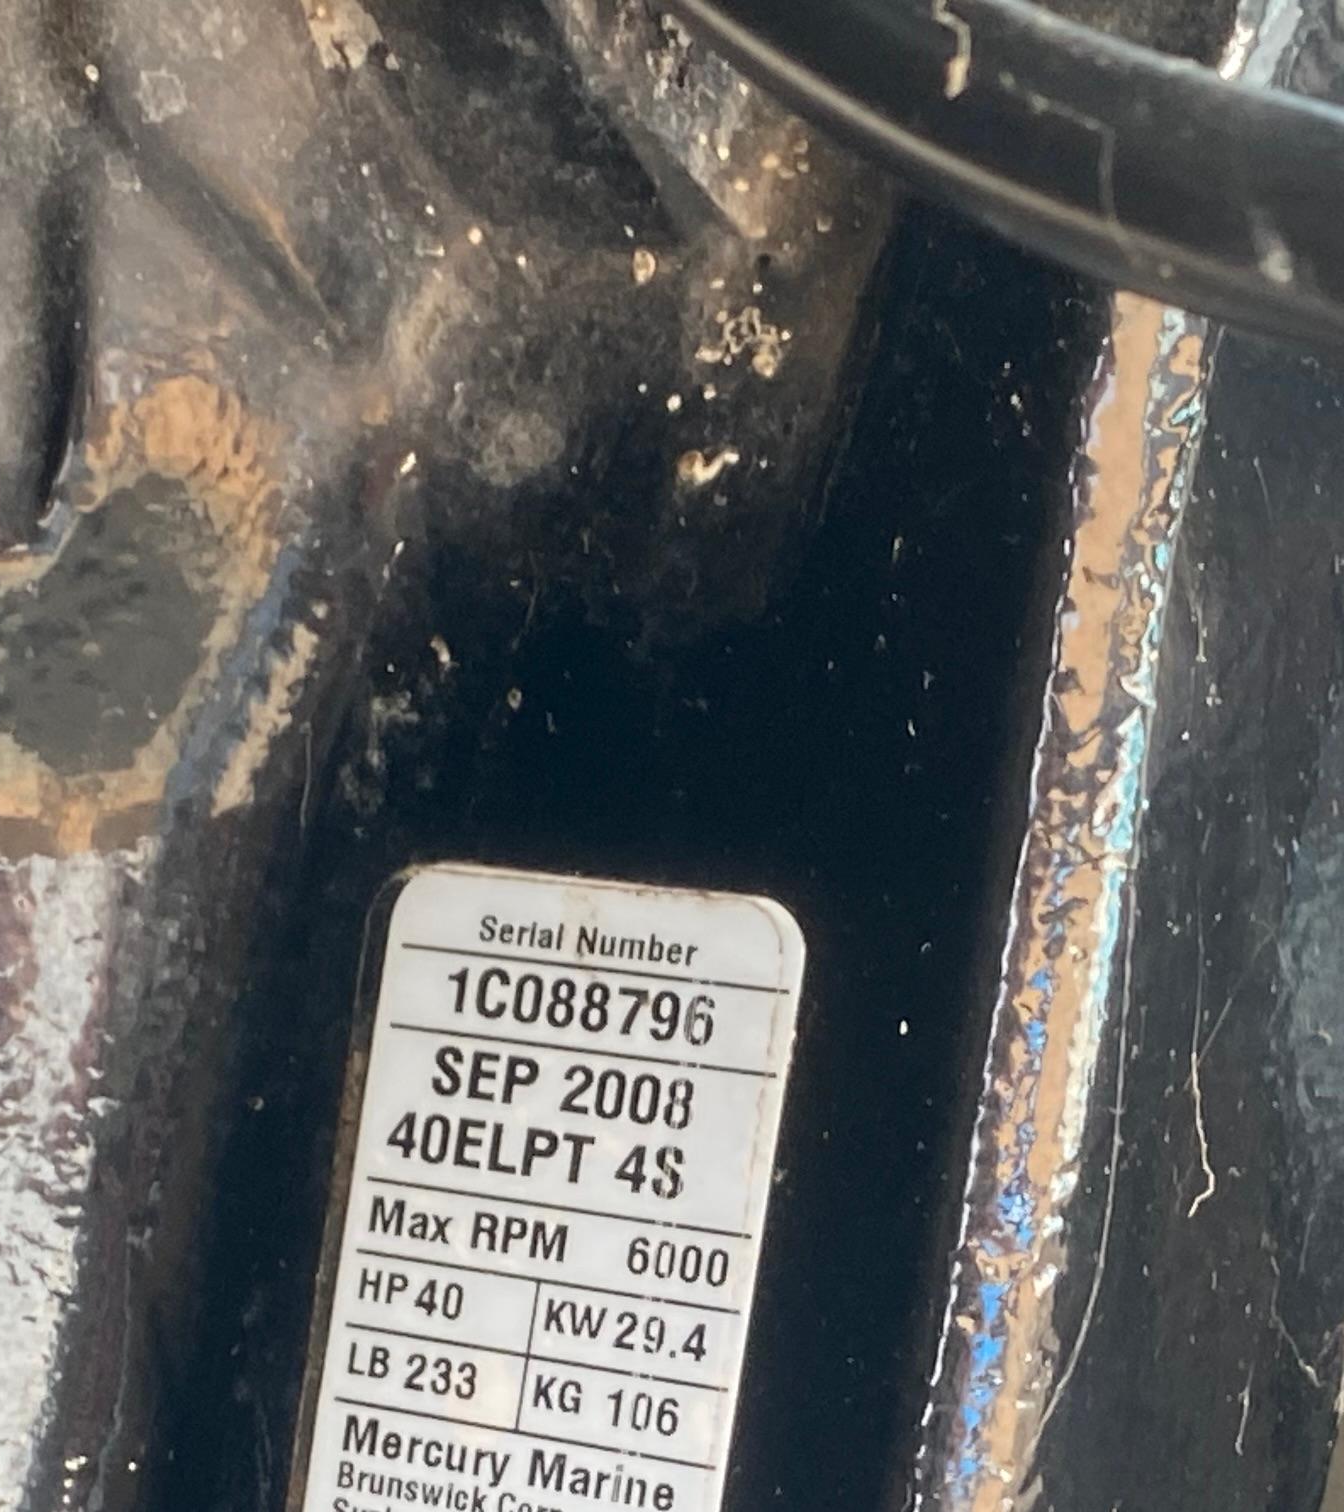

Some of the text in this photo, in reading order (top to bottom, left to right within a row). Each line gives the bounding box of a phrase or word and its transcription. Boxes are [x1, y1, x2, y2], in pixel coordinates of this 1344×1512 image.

[479, 915, 698, 966] Serial Number
[448, 967, 716, 1047] 1C088796
[432, 1046, 695, 1131] SEP 2008
[387, 1112, 686, 1200] 40ELPT 4S
[368, 1196, 729, 1287] Max RPM 6000
[358, 1268, 464, 1320] HP 40
[545, 1299, 707, 1362] KW 29.4
[347, 1342, 477, 1400] LB 233
[534, 1375, 679, 1436] KG 106
[342, 1414, 675, 1512] Mercury Marine
